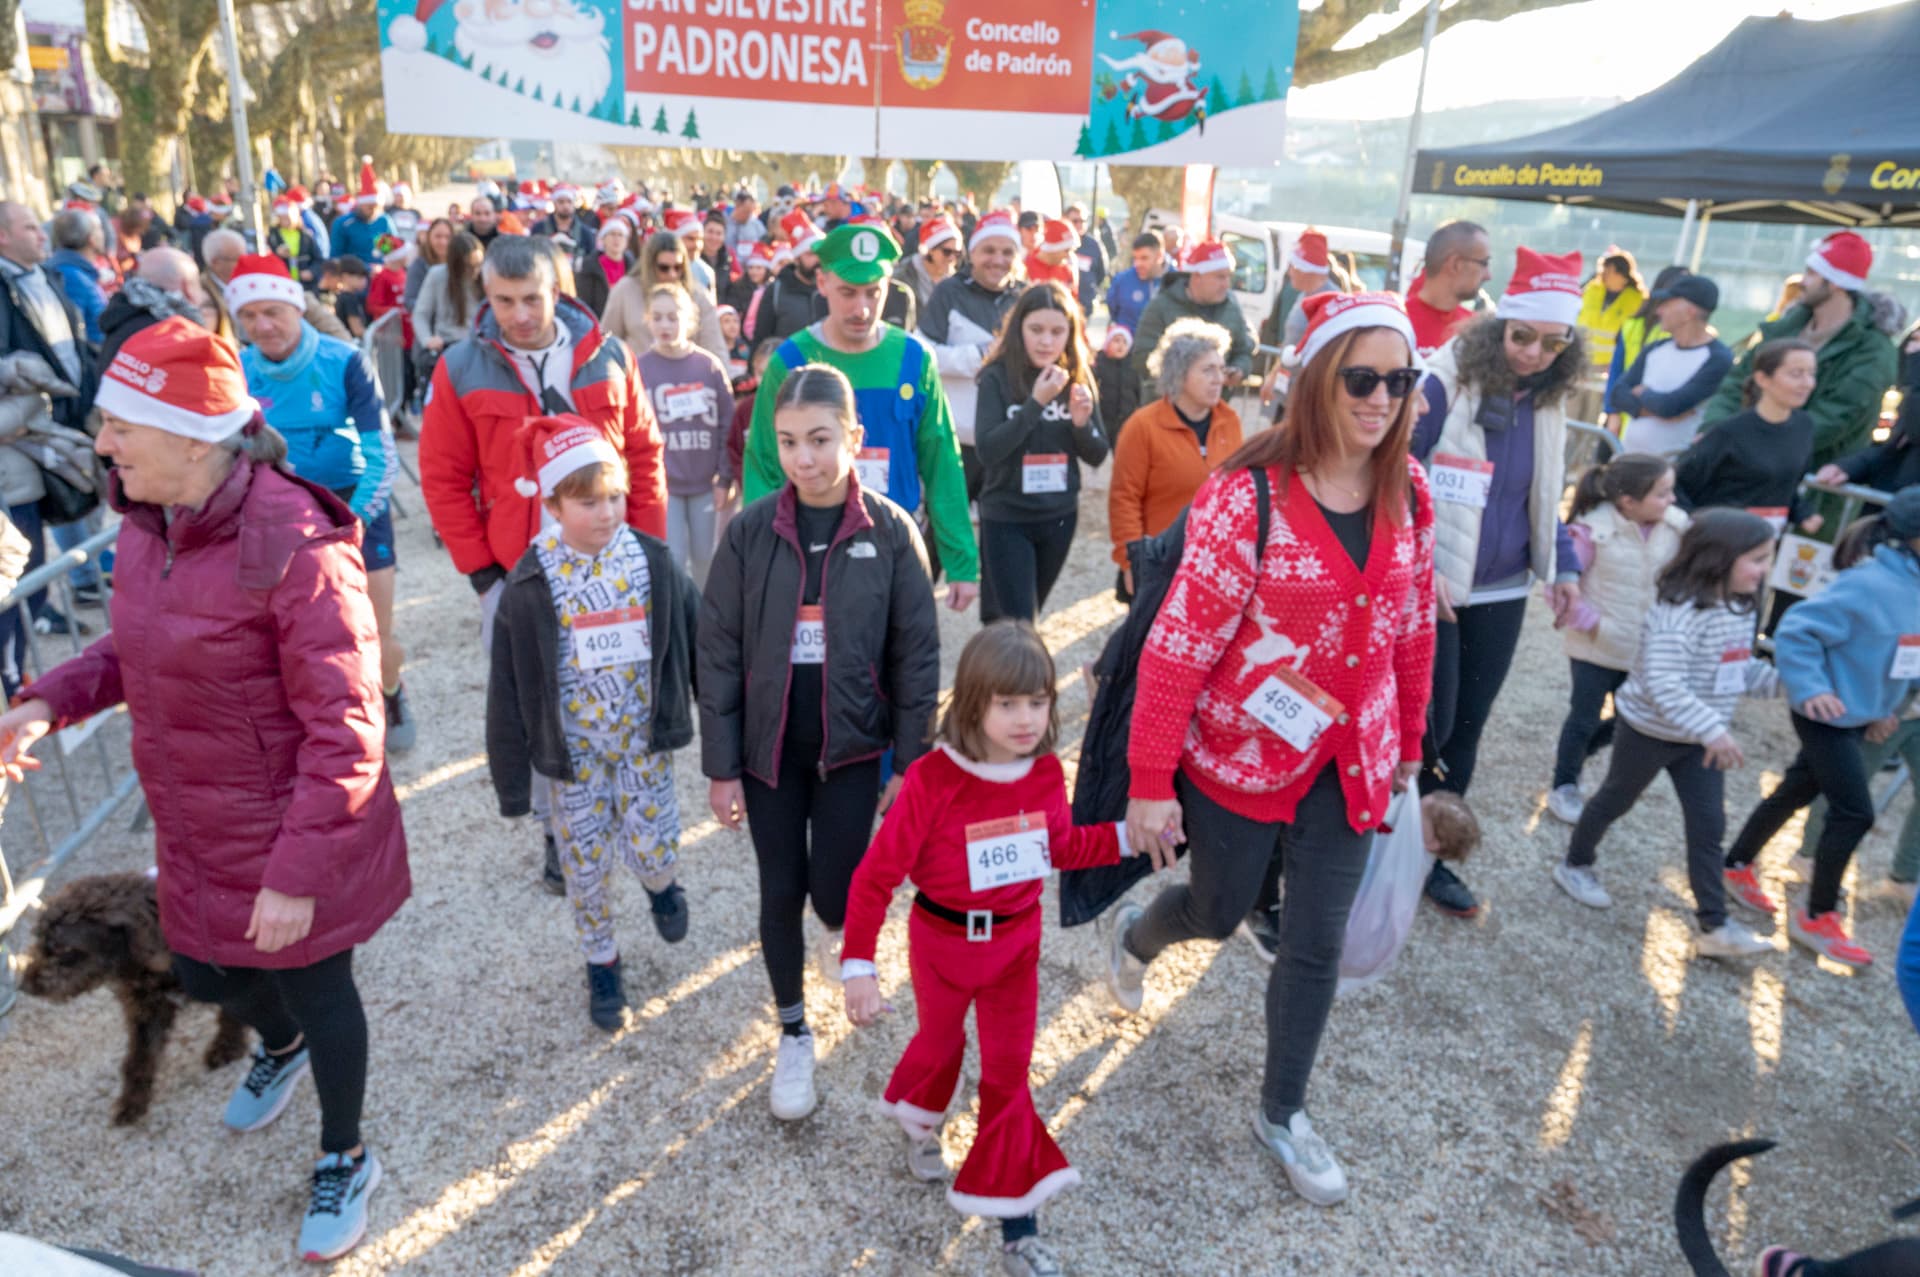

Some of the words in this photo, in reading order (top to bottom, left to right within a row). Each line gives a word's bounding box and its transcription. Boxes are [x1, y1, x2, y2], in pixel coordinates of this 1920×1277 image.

[965, 17, 1060, 45] Concello
[633, 22, 868, 87] PADRONESA
[965, 49, 992, 73] de
[996, 51, 1072, 76] Padrón
[1454, 164, 1516, 186] Concello
[1516, 163, 1538, 185] de
[1539, 162, 1603, 187] Padrón
[859, 238, 873, 256] L
[1435, 471, 1465, 490] 031
[585, 631, 623, 651] 402
[794, 629, 825, 647] 05
[1264, 689, 1302, 720] 465
[978, 843, 1018, 869] 466
